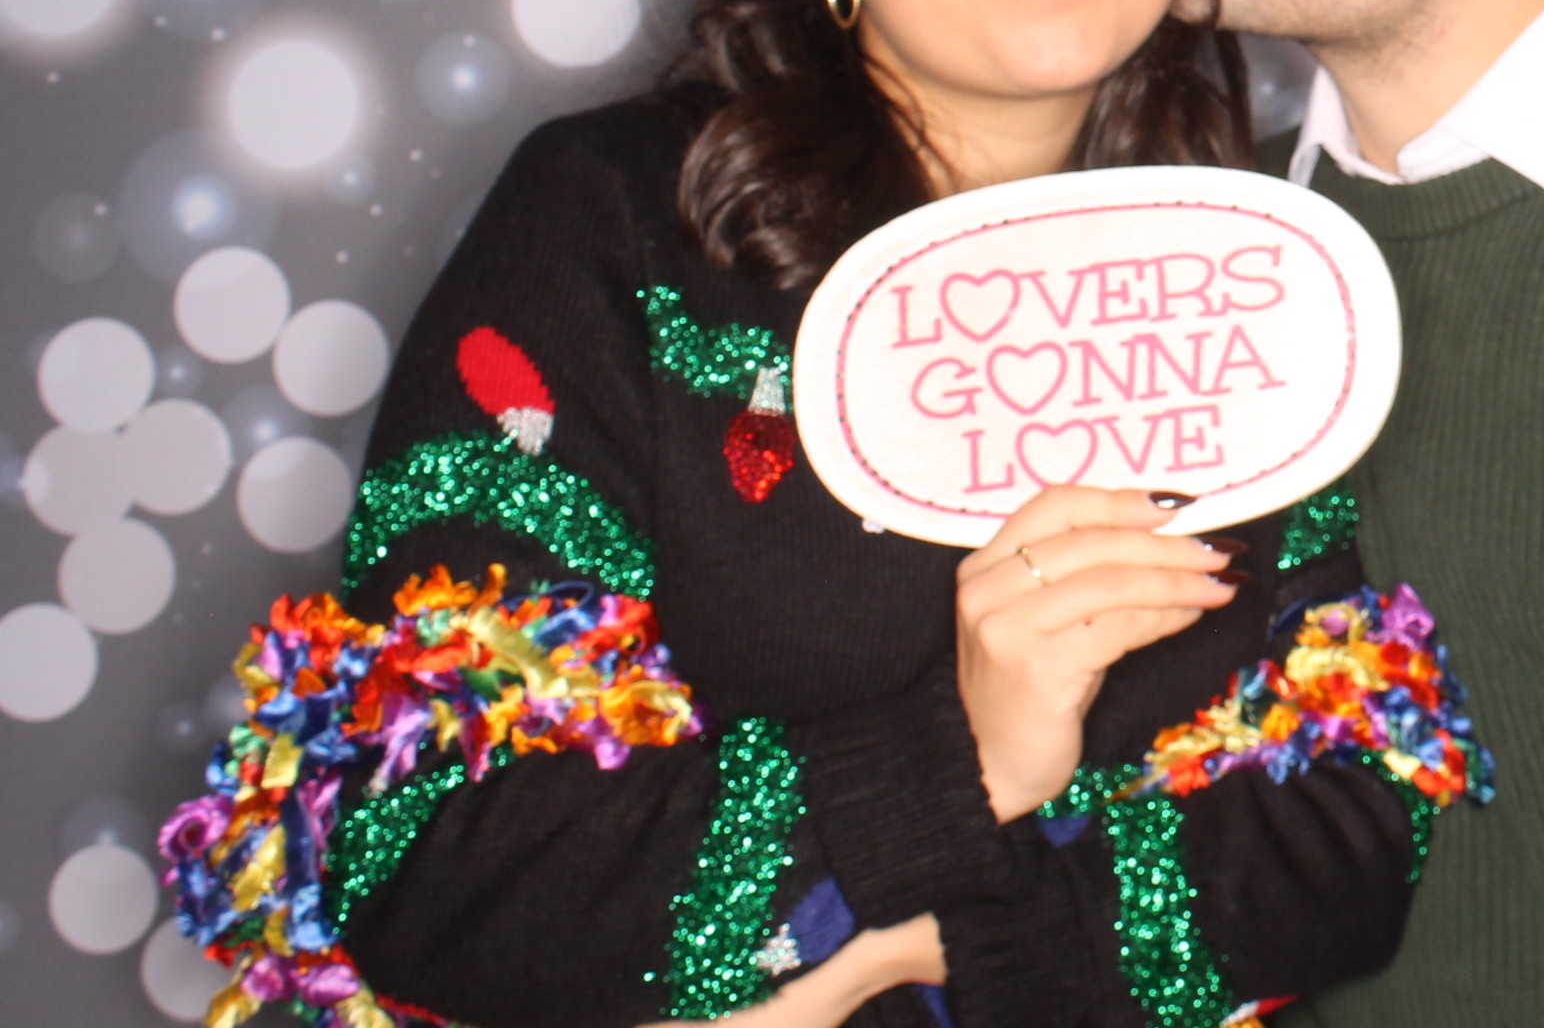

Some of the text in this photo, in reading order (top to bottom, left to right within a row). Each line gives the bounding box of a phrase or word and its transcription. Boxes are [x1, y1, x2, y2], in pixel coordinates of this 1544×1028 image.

[890, 244, 1286, 349] LOVERS
[910, 324, 1287, 419] GONNA
[961, 404, 1225, 494] LOVE
